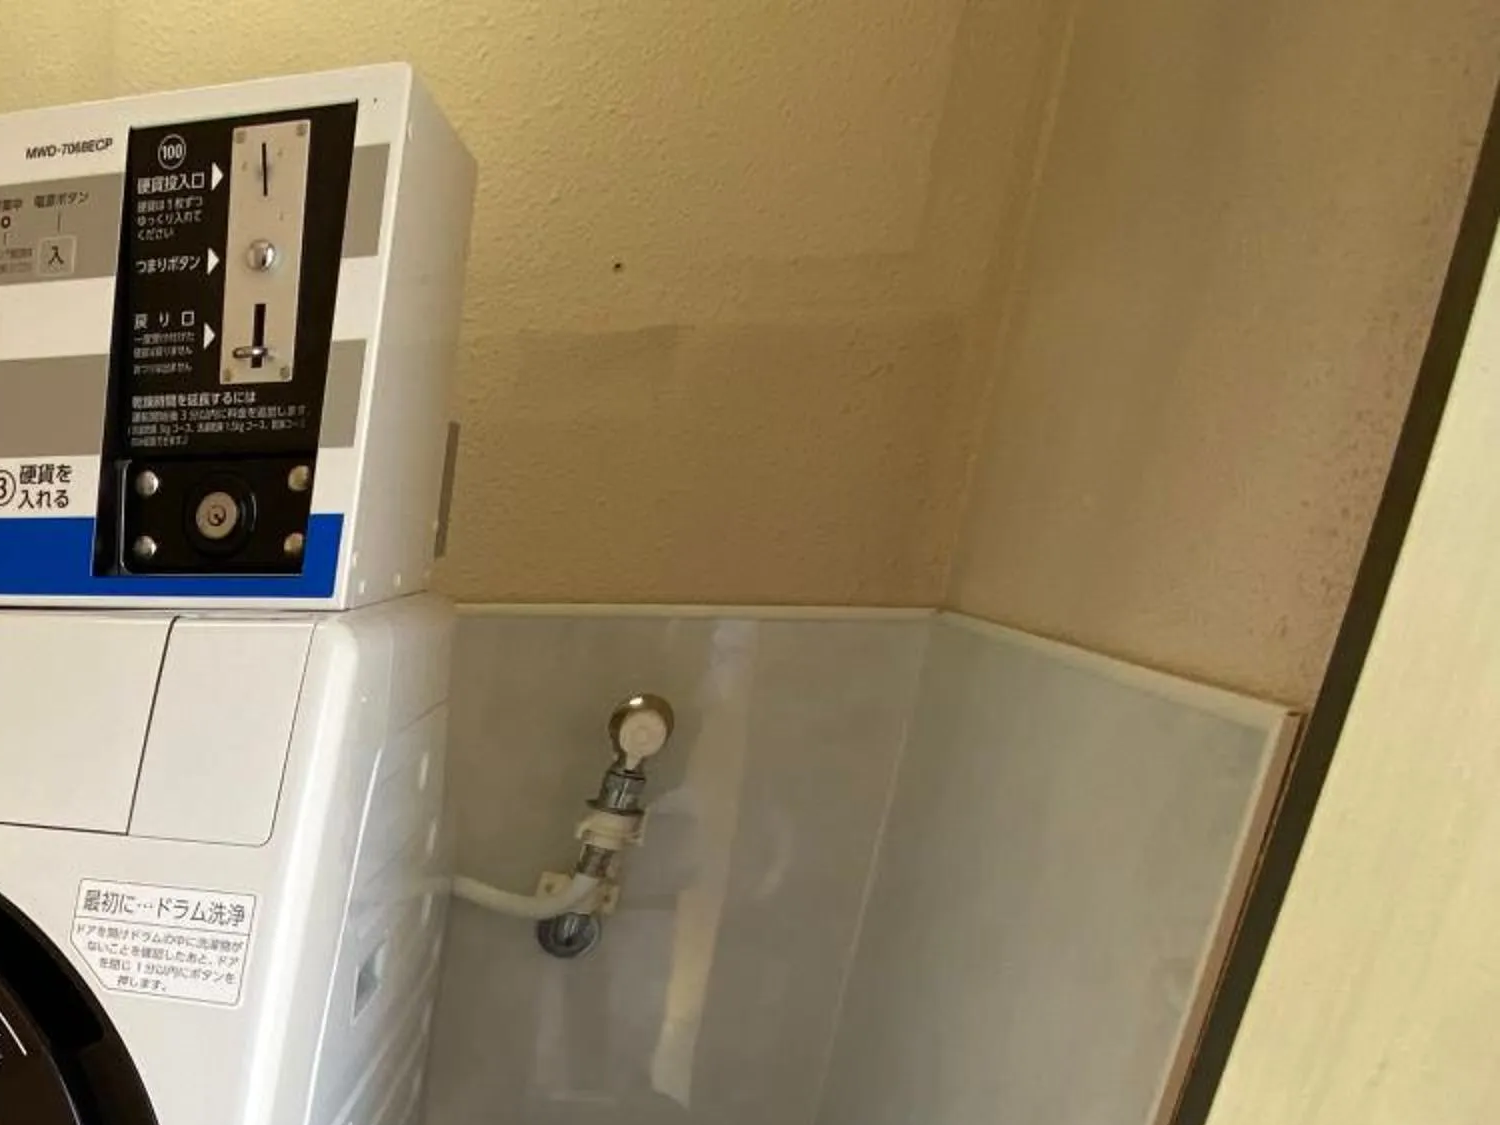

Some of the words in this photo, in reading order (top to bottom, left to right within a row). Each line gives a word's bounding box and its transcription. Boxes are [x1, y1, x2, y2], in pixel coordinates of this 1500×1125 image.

[162, 145, 183, 160] 100
[137, 172, 205, 194] 硬貨投入口
[48, 246, 64, 263] 入
[135, 255, 201, 274] つまりボタン
[19, 463, 73, 486] 硬貨を
[18, 489, 70, 510] 入れる
[117, 975, 167, 992] 押します。
